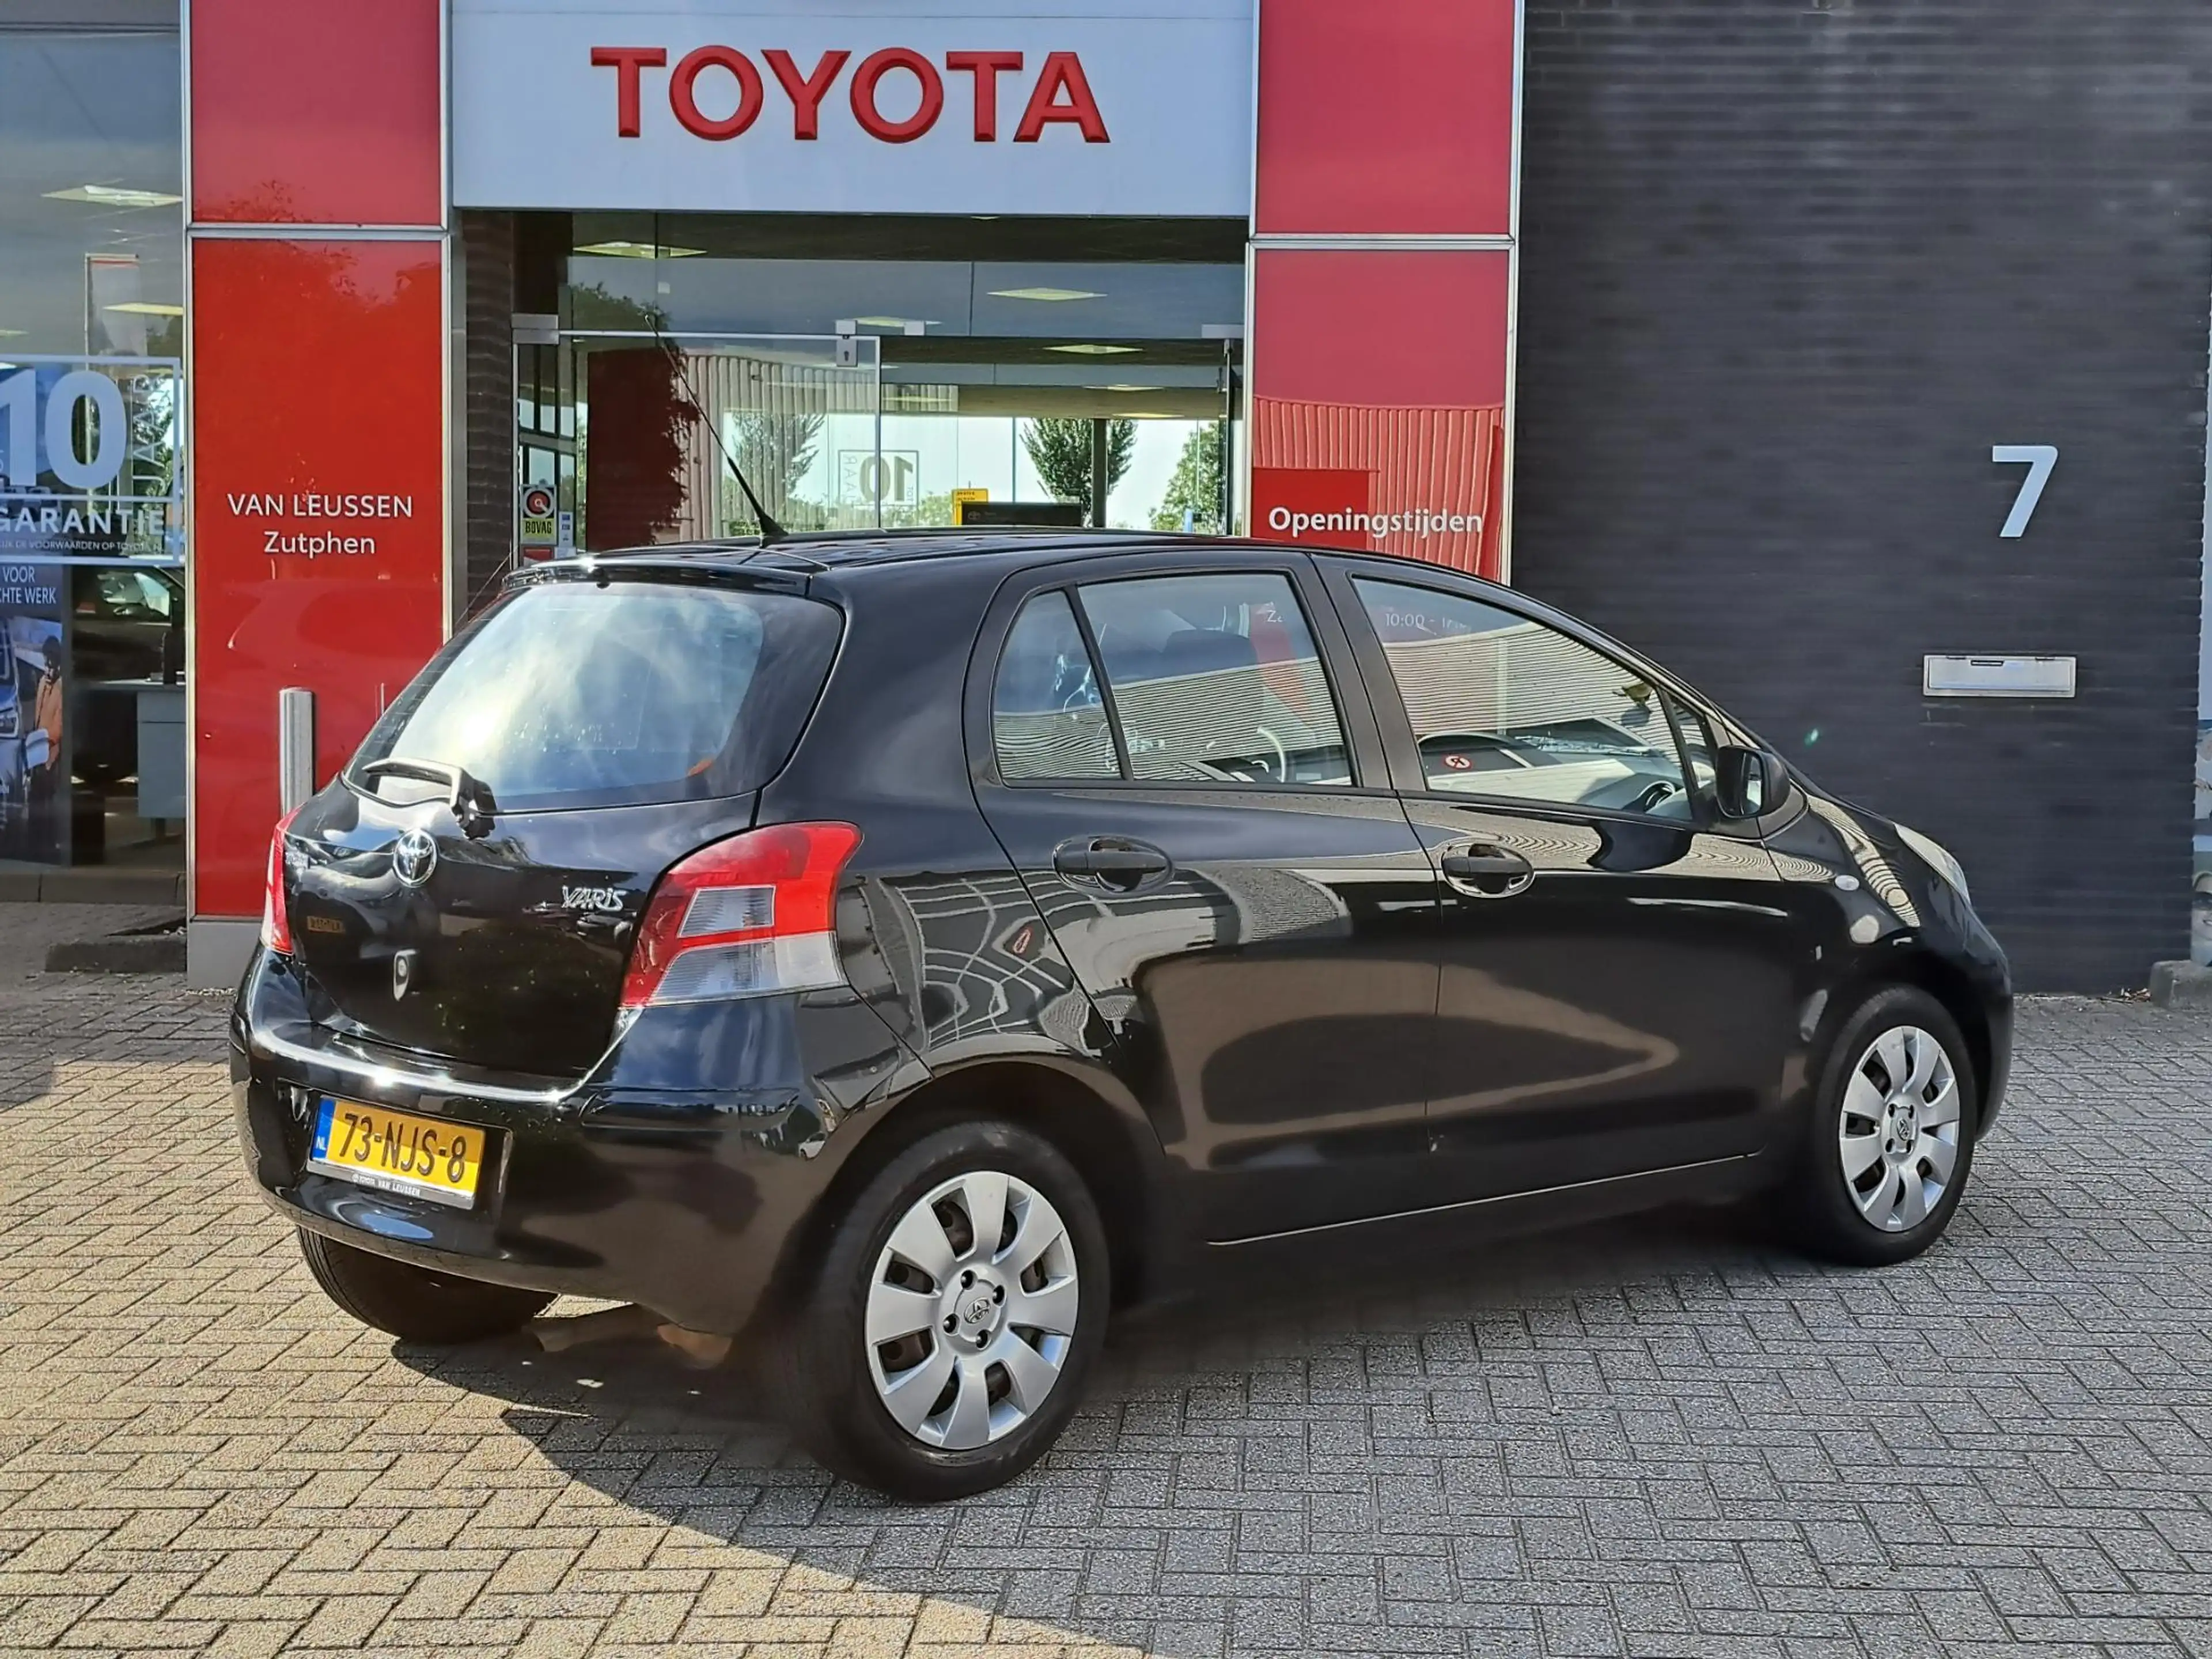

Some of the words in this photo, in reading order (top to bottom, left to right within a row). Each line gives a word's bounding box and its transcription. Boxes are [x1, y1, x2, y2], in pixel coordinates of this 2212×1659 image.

[591, 45, 1111, 144] TOYOTA
[0, 368, 127, 489] 10
[1993, 445, 2058, 537] 7
[227, 493, 283, 517] VAN
[293, 494, 412, 518] LEUSSEN
[525, 520, 552, 534] BOVAG
[1268, 506, 1483, 539] Openingstijden
[30, 540, 100, 551] VOORWAARDEN
[101, 541, 115, 551] OP
[263, 531, 376, 559] Zutphen
[2, 565, 36, 584] VOOR
[0, 587, 22, 604] HTE
[24, 587, 57, 605] WERK
[561, 885, 628, 911] YARIS
[315, 1135, 327, 1151] NL
[339, 1112, 467, 1183] 73-NJS-8
